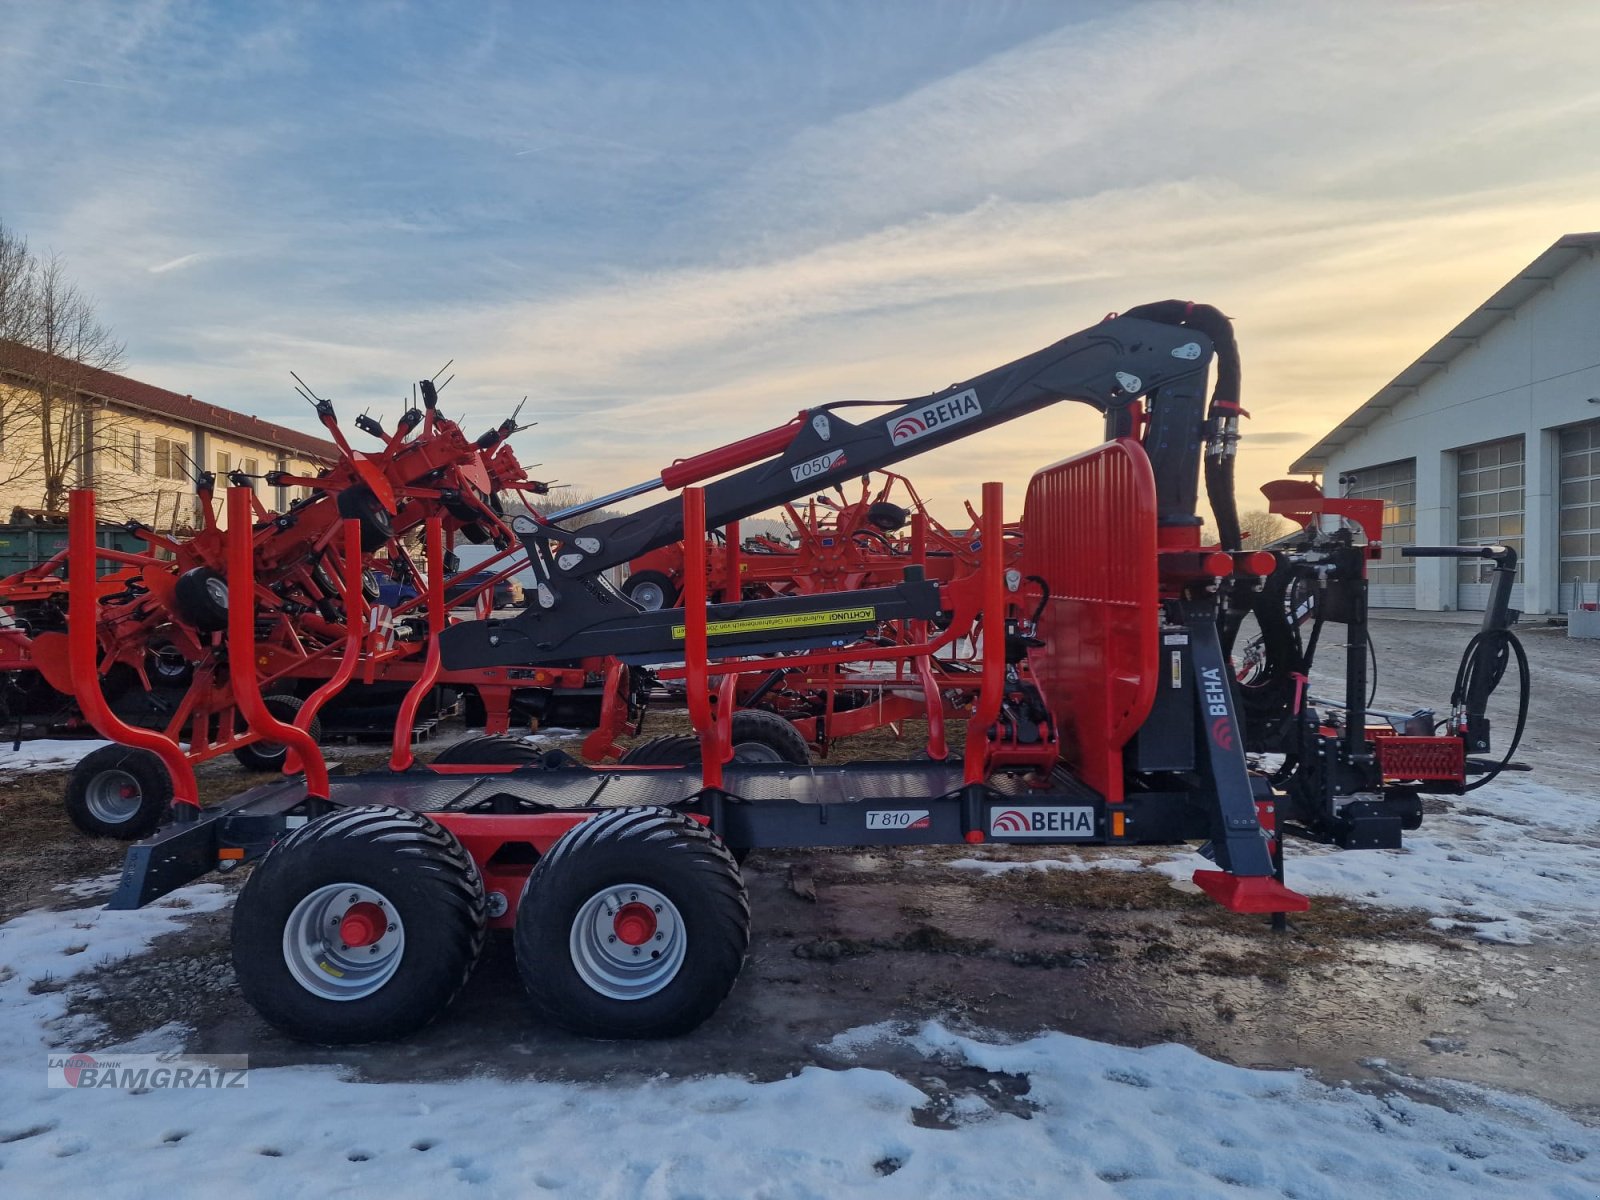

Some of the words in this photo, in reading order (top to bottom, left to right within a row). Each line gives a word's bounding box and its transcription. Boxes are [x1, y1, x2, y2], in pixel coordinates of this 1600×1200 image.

[922, 395, 978, 428] BEHA
[792, 456, 831, 480] 7050
[829, 610, 871, 620] ACHTUNG!
[1203, 668, 1228, 716] BEHA
[868, 813, 880, 826] T
[882, 813, 910, 826] 810
[1032, 812, 1091, 831] BEHA
